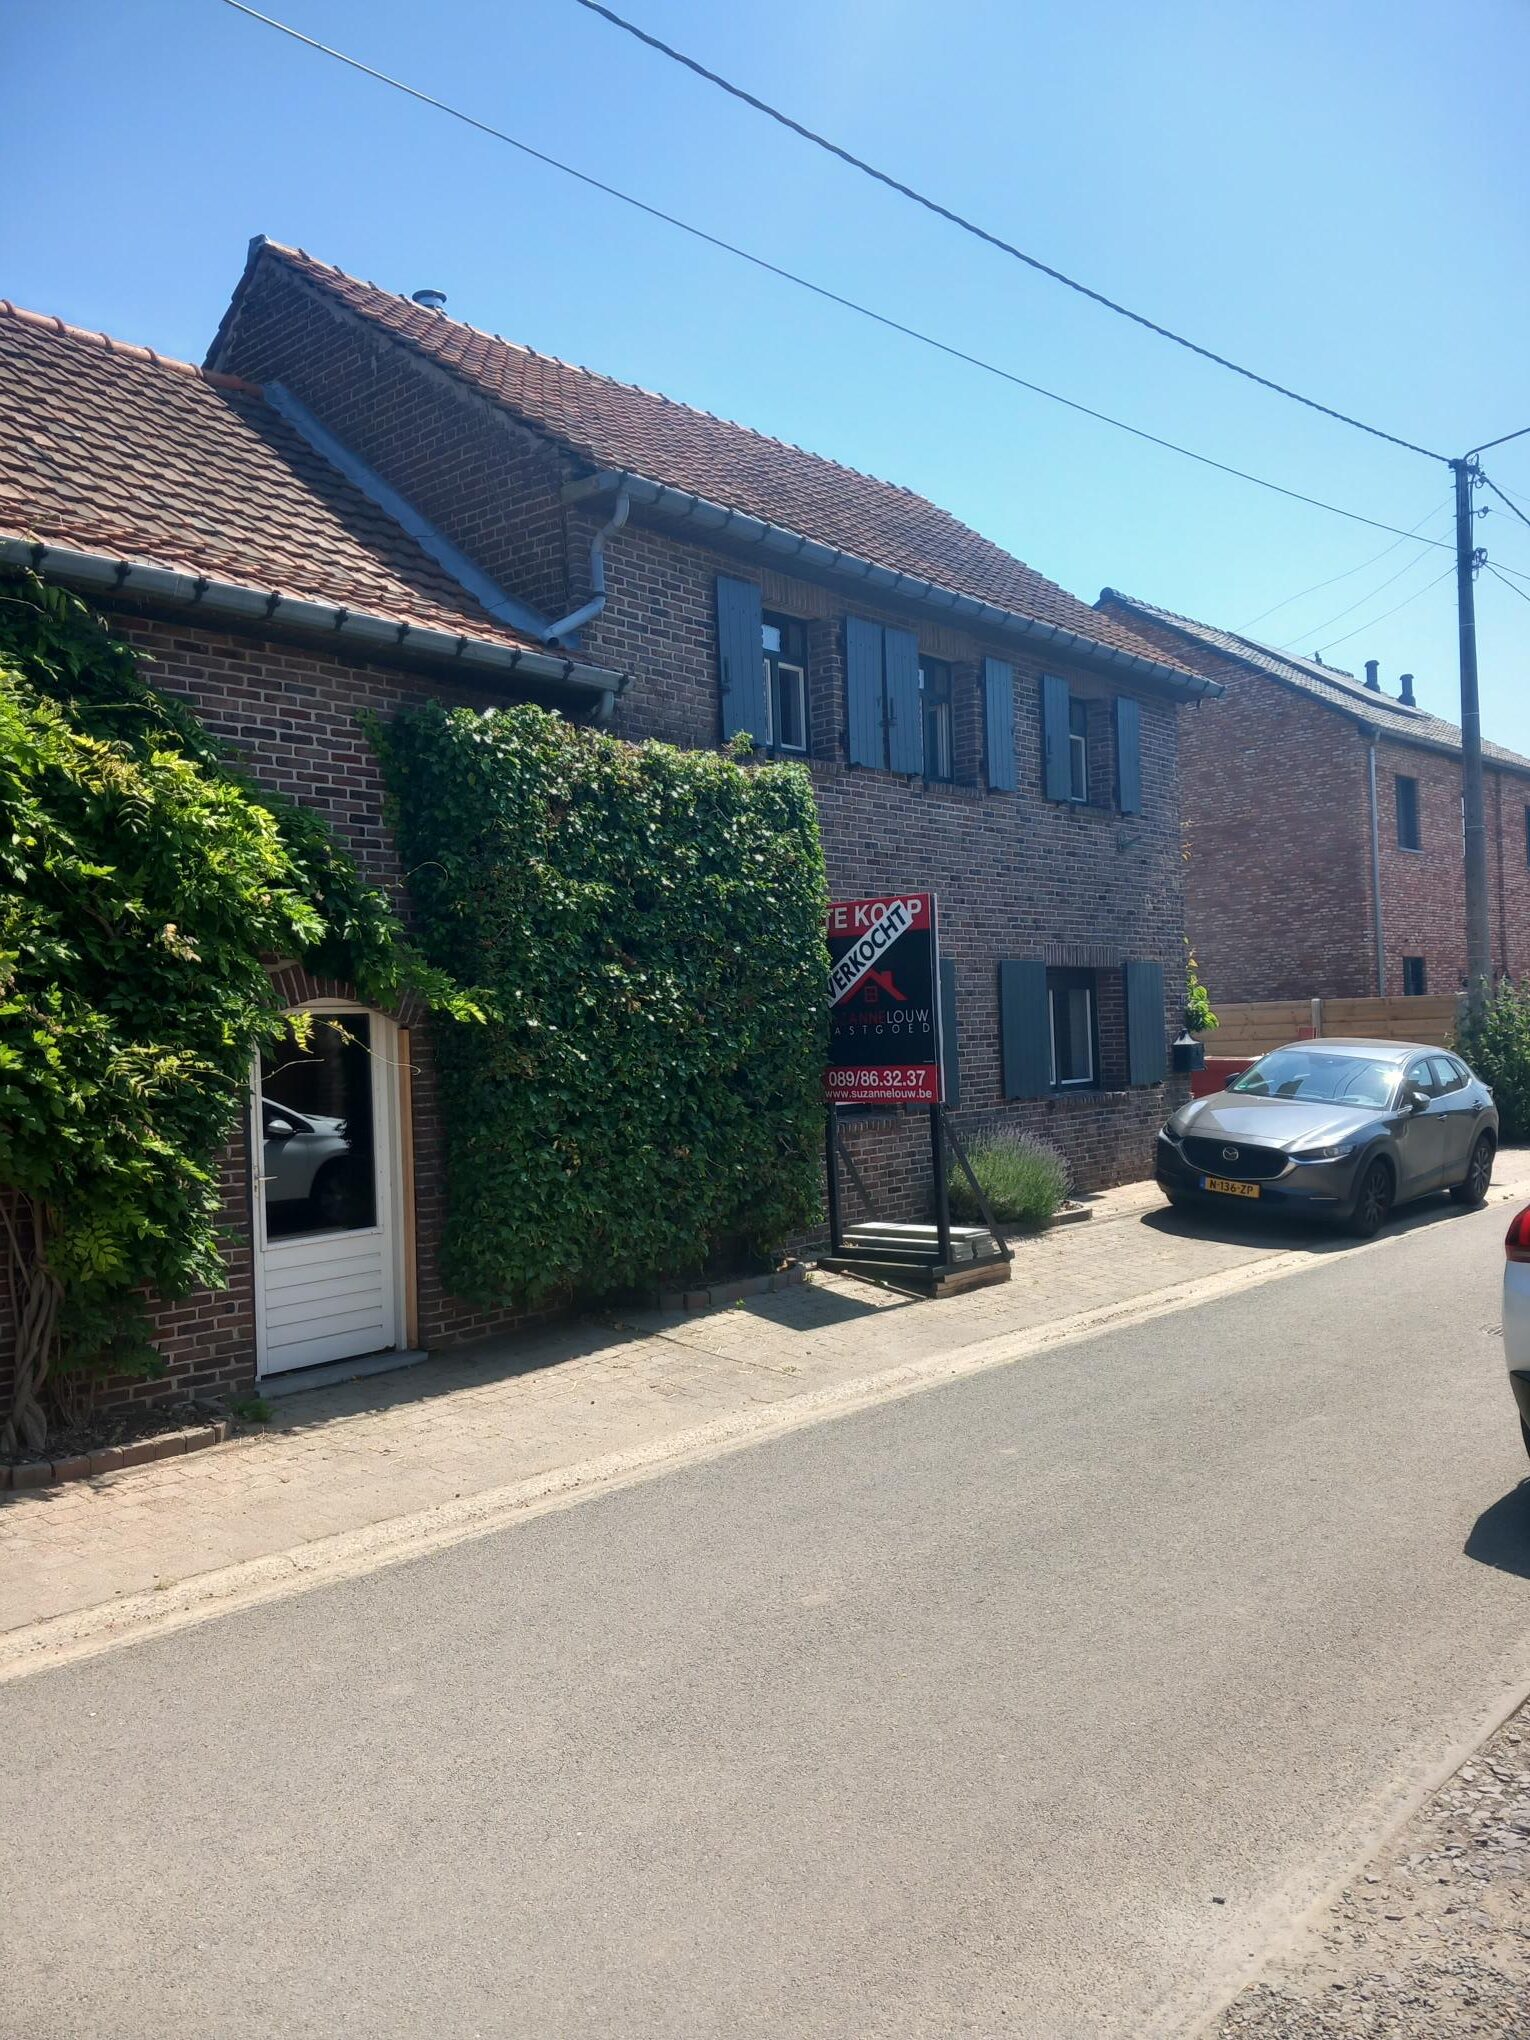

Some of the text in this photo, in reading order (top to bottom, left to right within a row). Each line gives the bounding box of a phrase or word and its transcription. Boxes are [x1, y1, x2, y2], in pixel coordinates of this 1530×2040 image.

[827, 904, 906, 999] VERKOCHT
[834, 1022, 931, 1035] ASTGOED
[828, 1069, 926, 1087] 089/86.32.37
[825, 1088, 932, 1099] www.suzannelouw.be
[1209, 1179, 1254, 1195] N-136-ZP
